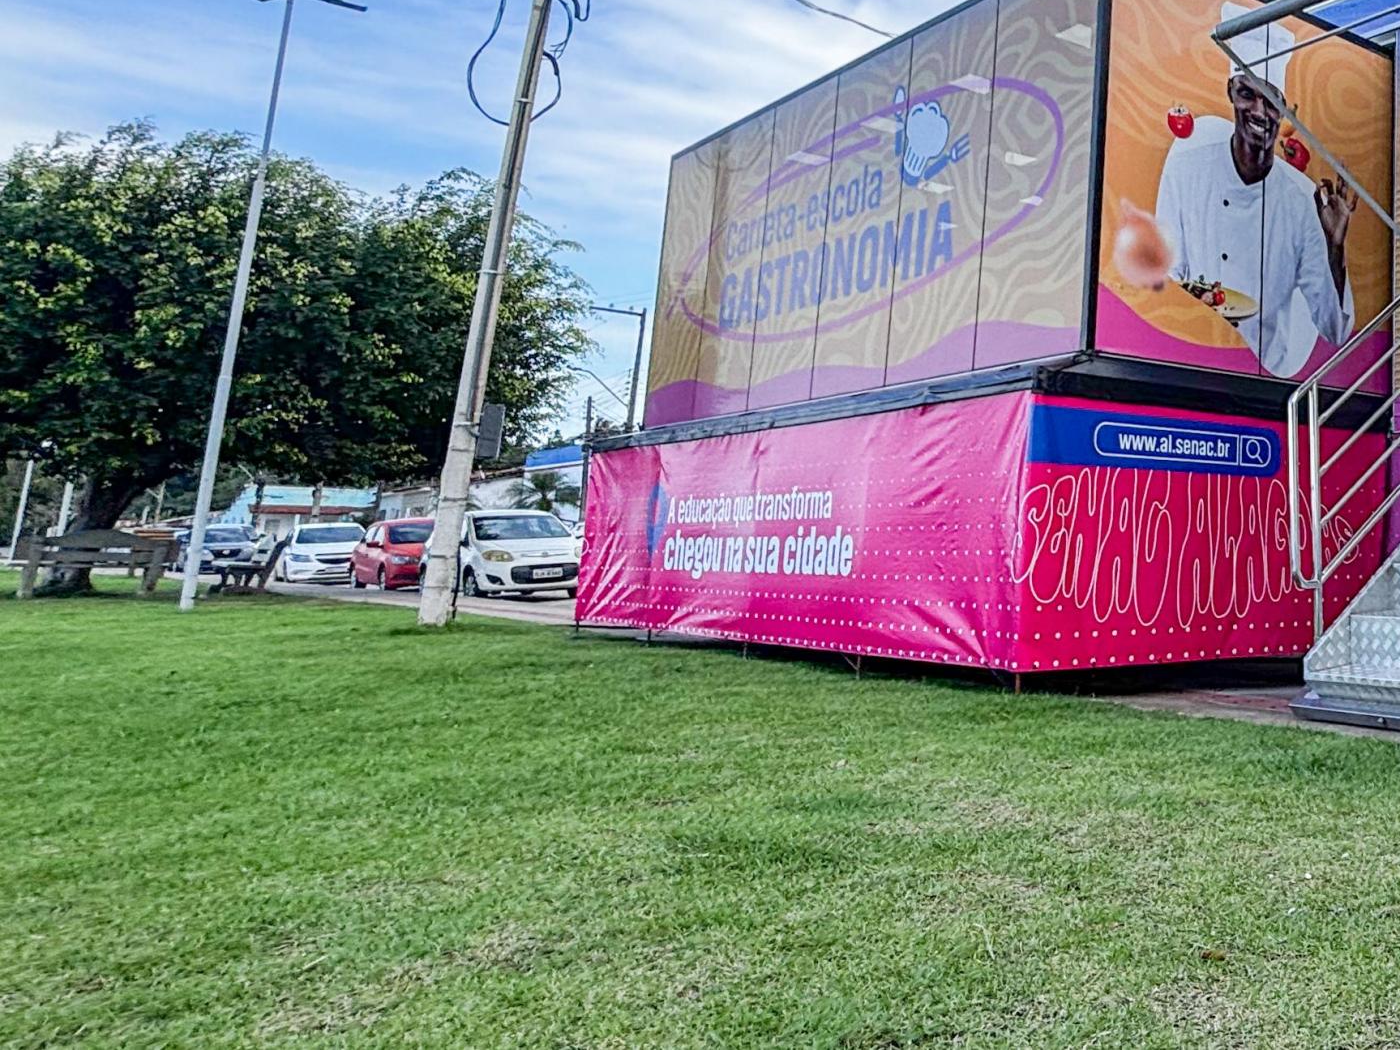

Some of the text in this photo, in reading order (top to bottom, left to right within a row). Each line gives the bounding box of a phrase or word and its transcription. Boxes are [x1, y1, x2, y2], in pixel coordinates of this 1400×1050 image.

[719, 200, 953, 330] GASTRONOMIA
[1118, 433, 1231, 458] www.al.senac.br
[667, 486, 832, 529] A educação que transforma
[664, 525, 853, 579] chegou na sua cidade
